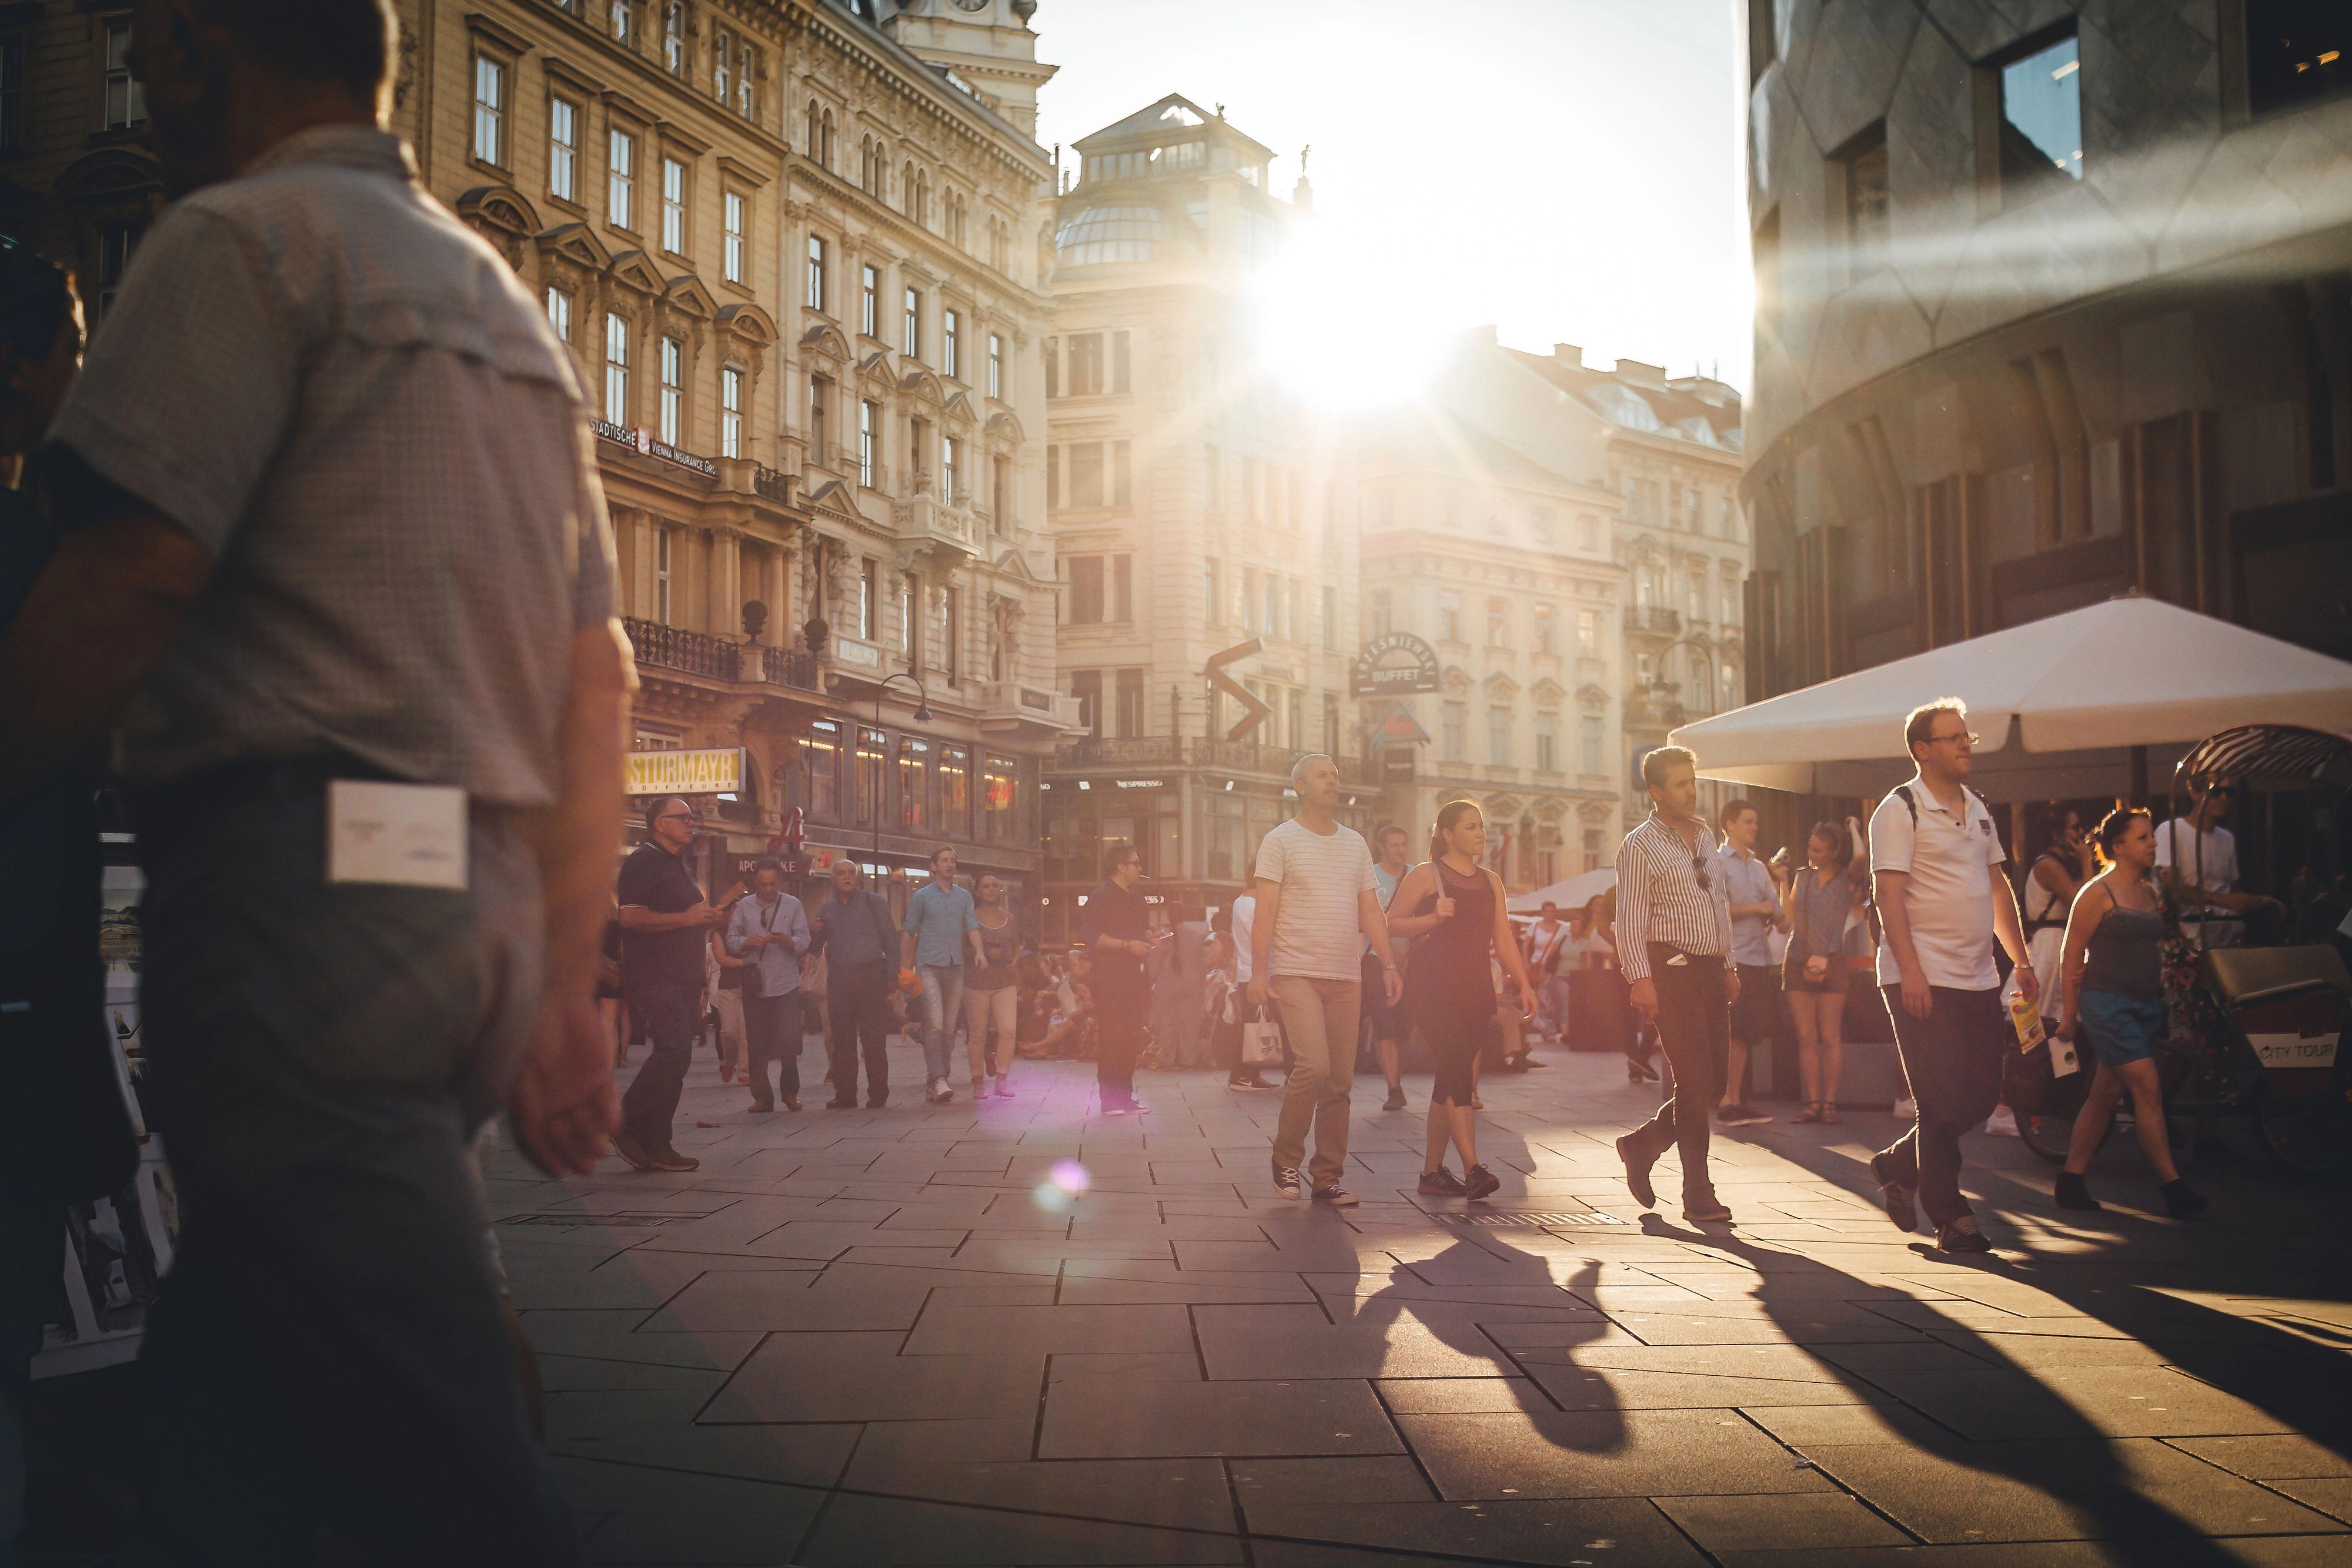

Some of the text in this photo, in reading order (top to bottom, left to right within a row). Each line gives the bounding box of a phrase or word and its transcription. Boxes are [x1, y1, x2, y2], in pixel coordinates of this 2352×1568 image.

[652, 440, 671, 459] VIENNA
[674, 449, 703, 470] INSURANCE
[1372, 668, 1420, 682] BUFFET
[629, 752, 733, 784] STURMAYR
[739, 860, 796, 872] APOKE
